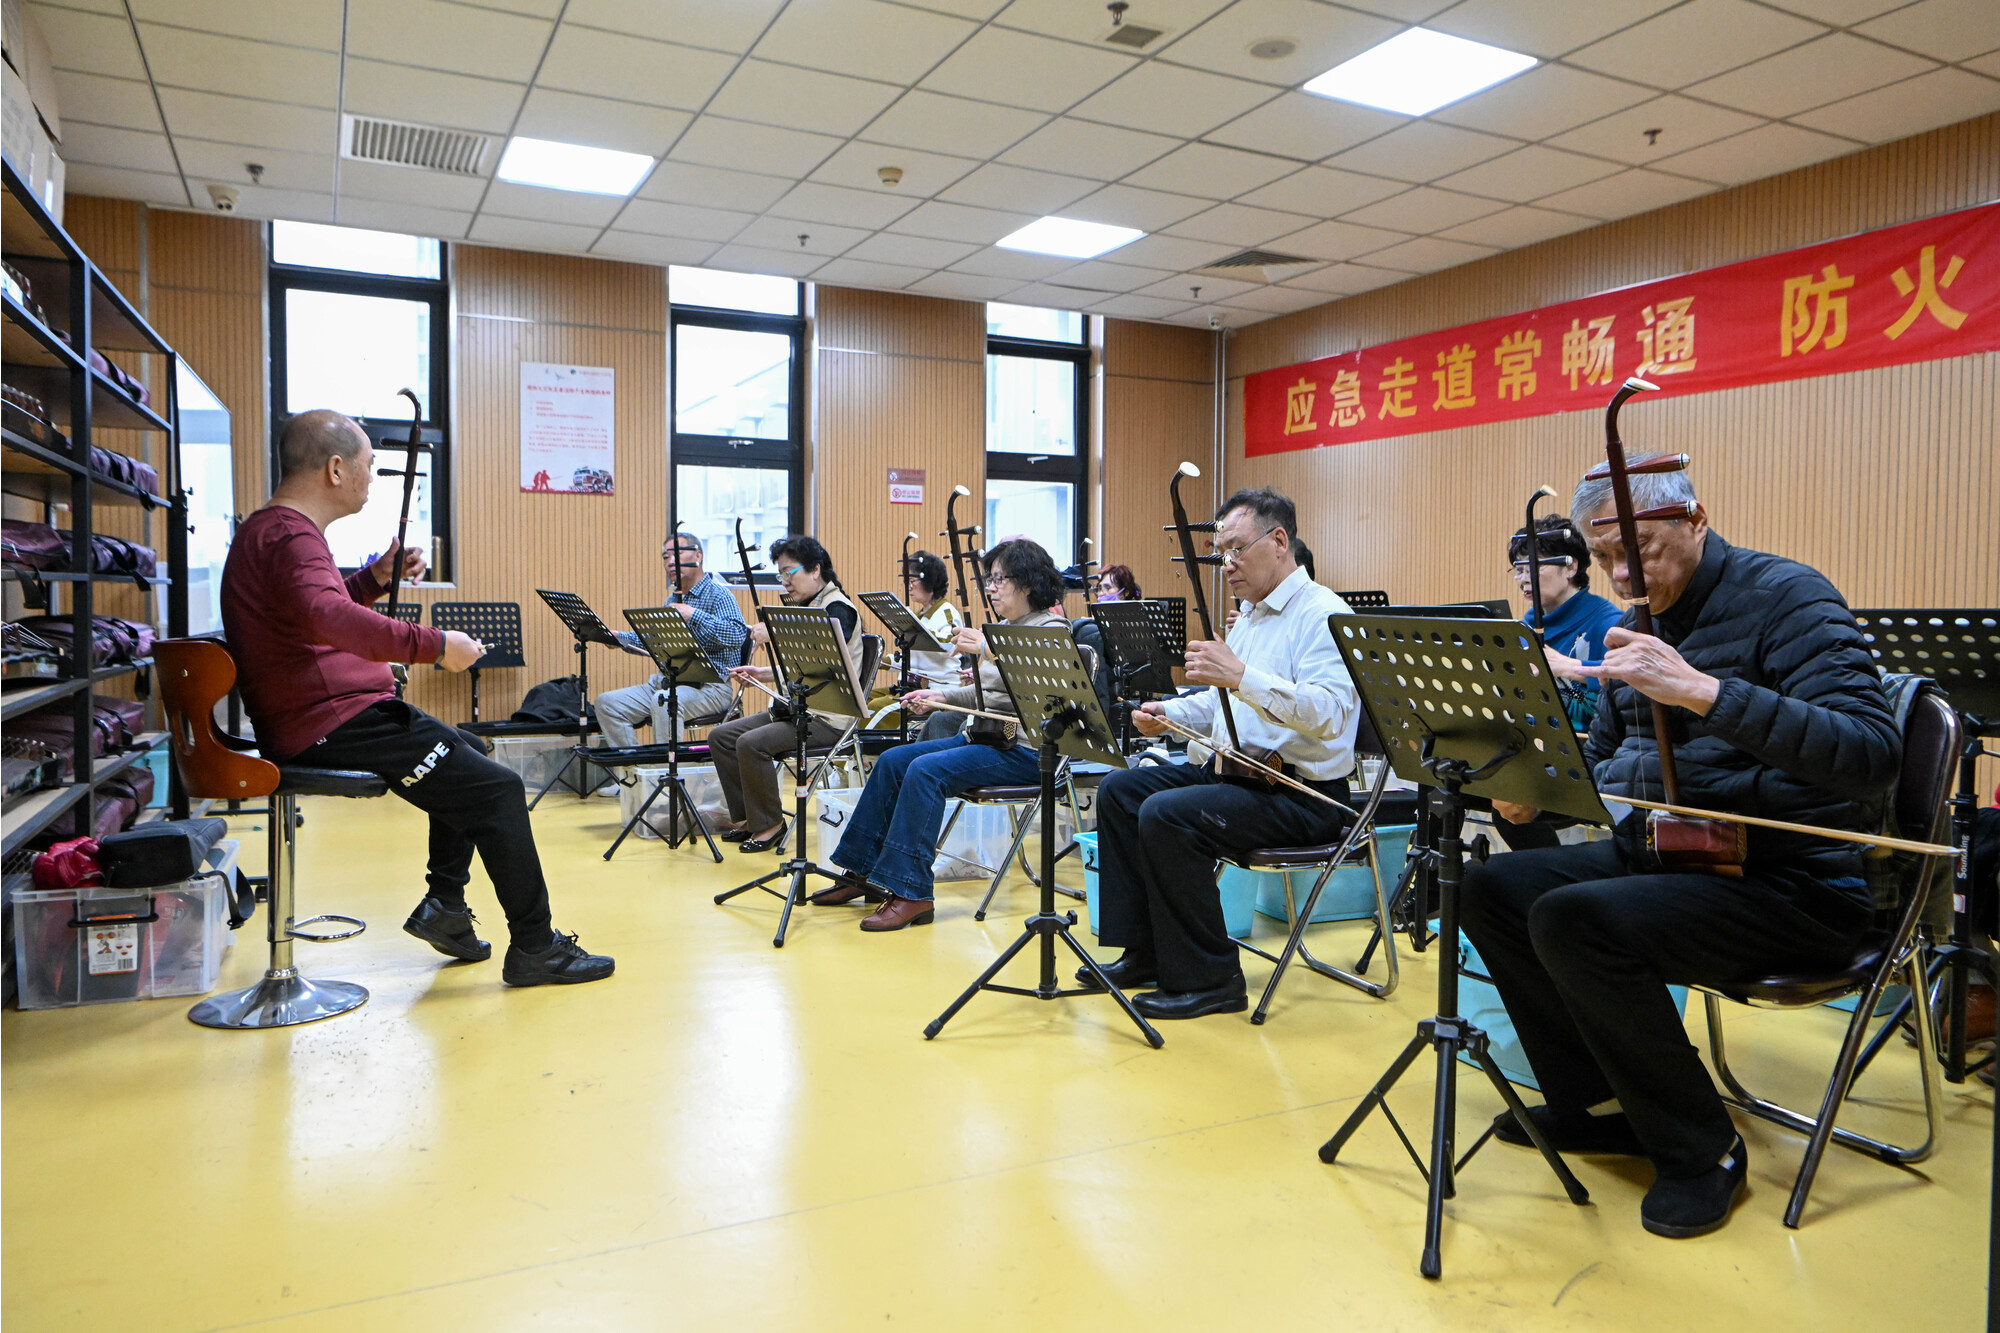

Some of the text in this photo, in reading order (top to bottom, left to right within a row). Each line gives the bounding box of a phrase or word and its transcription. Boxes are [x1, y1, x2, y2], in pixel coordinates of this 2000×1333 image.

[1284, 245, 1969, 436] 应急走道常畅通 防火
[401, 741, 450, 788] AAPE
